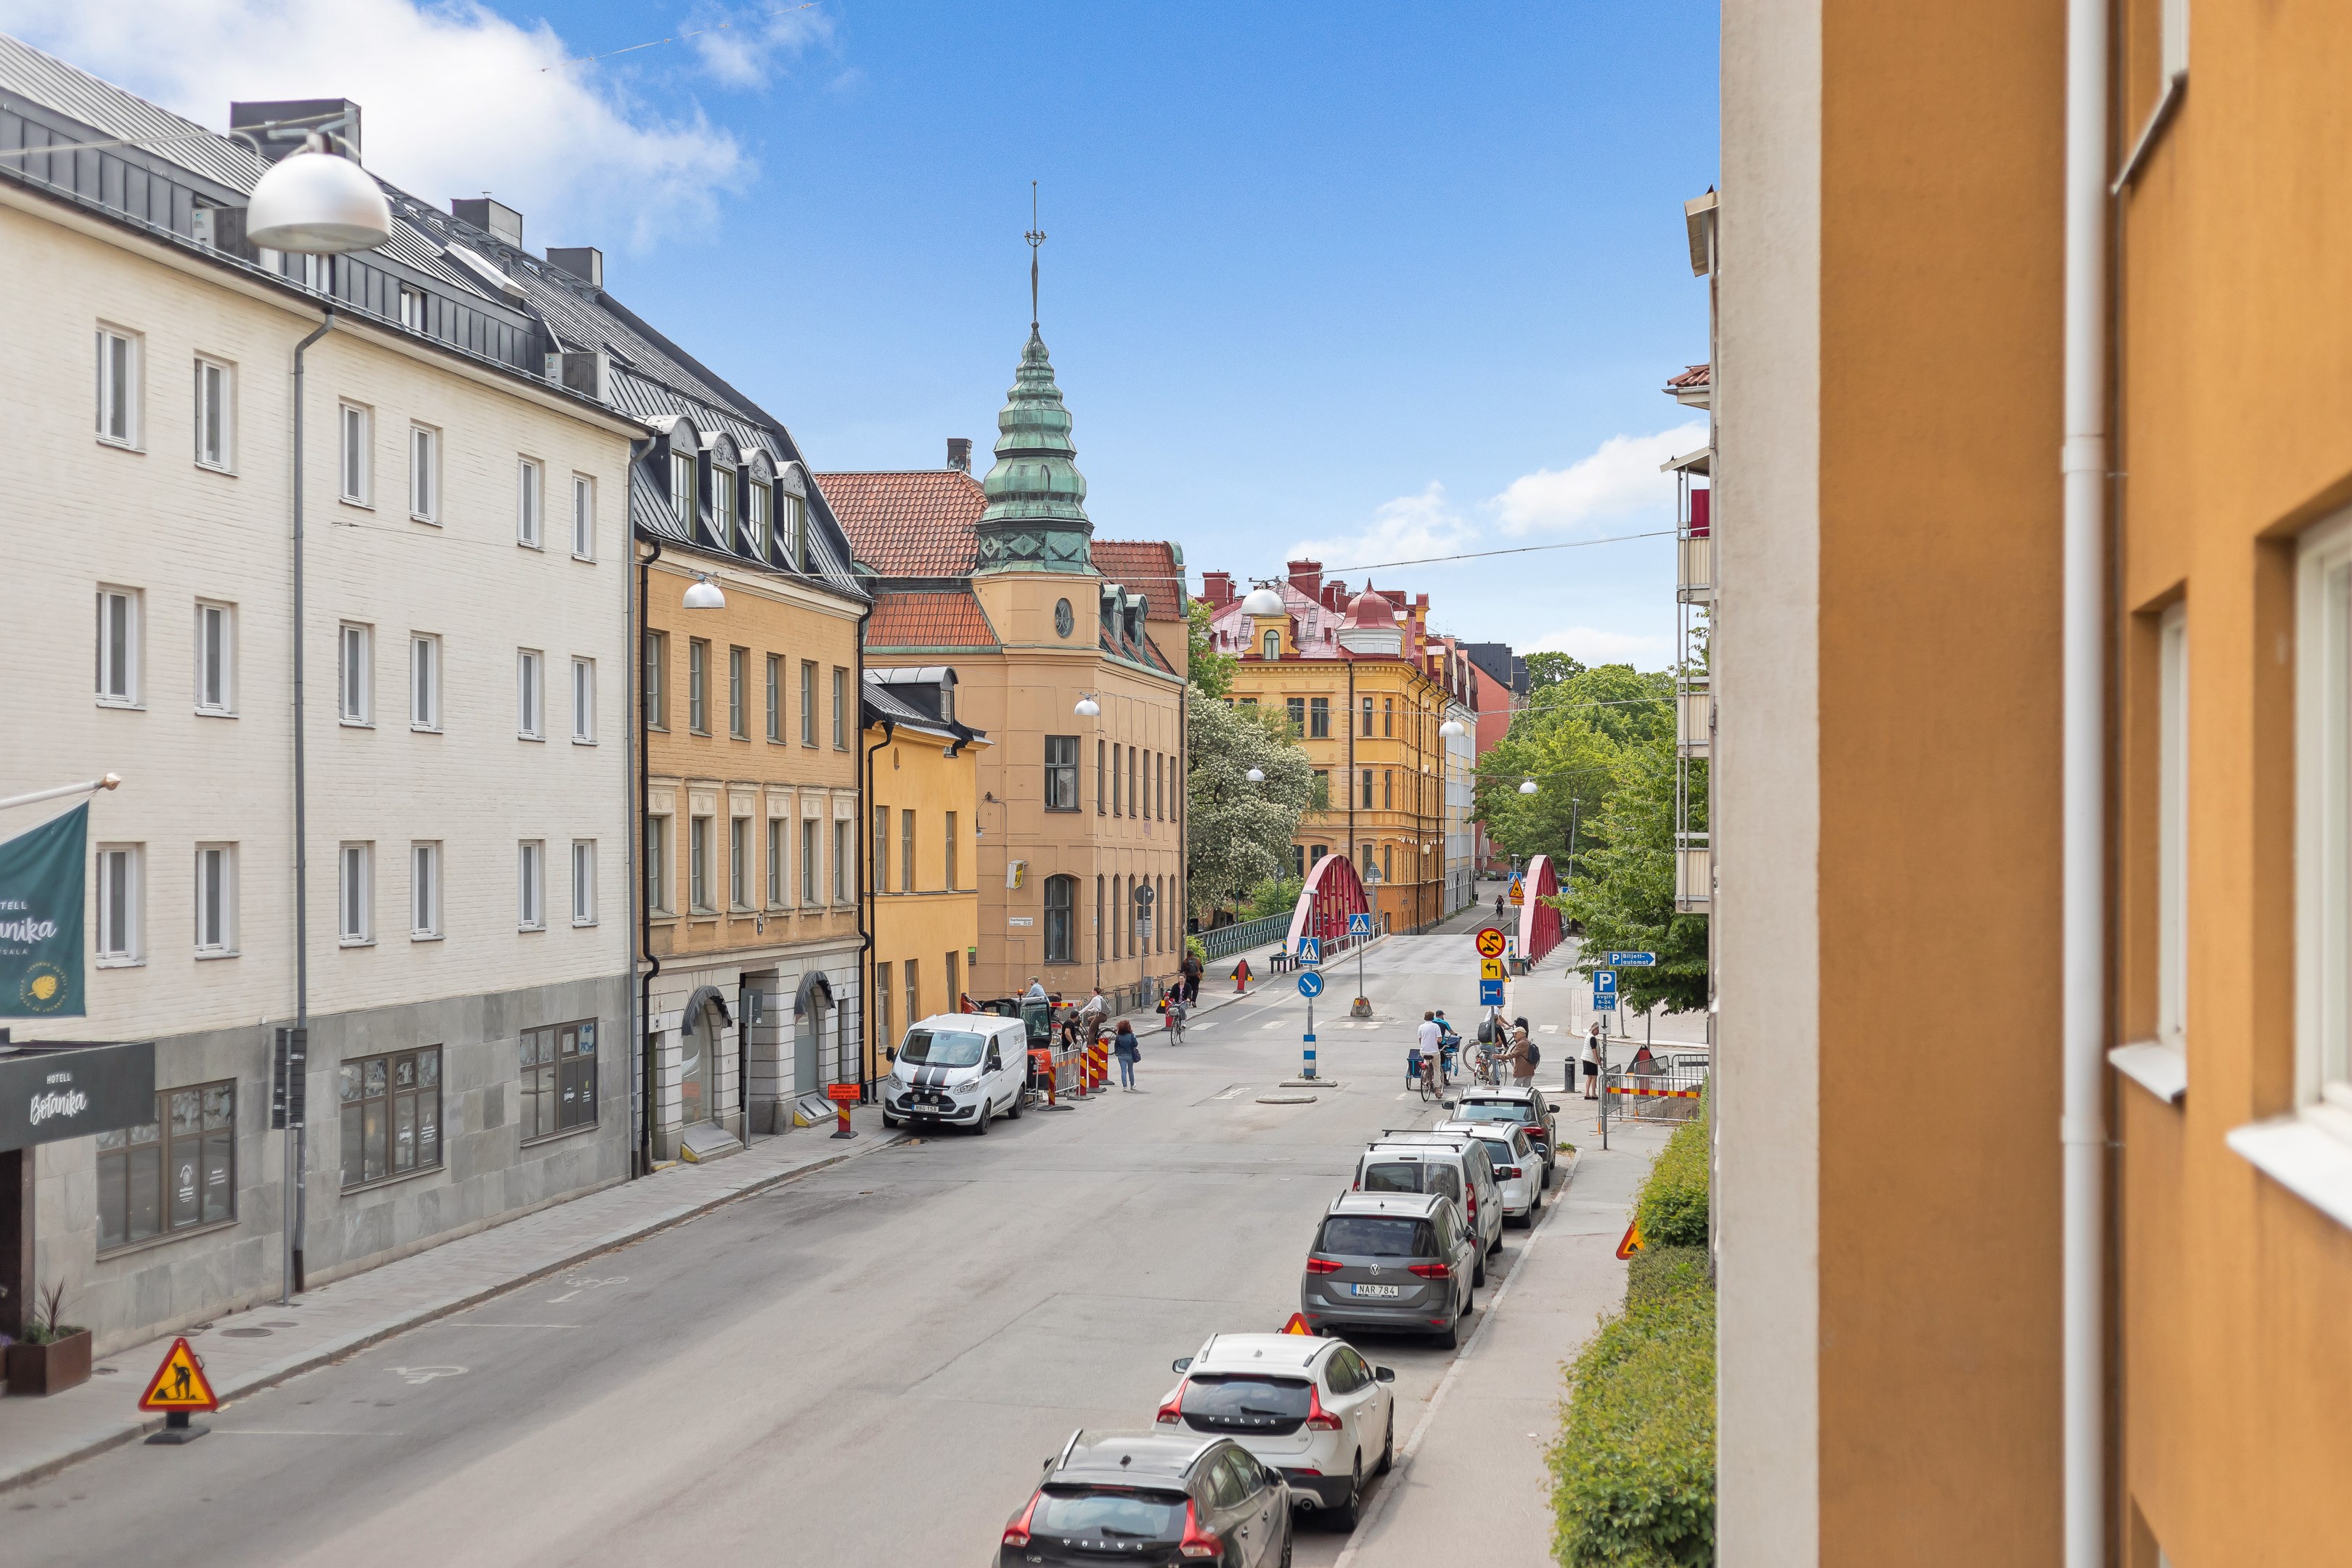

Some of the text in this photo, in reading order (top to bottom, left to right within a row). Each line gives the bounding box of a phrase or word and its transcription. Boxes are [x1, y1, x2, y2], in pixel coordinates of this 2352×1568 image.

[1612, 954, 1620, 964] P
[1599, 973, 1612, 992] P
[46, 1073, 71, 1085] HOTELL
[30, 1090, 87, 1126] Botanika
[1359, 1285, 1395, 1295] NAR 784
[1209, 1416, 1275, 1425] VOLVO
[1063, 1538, 1143, 1551] VOLVO
